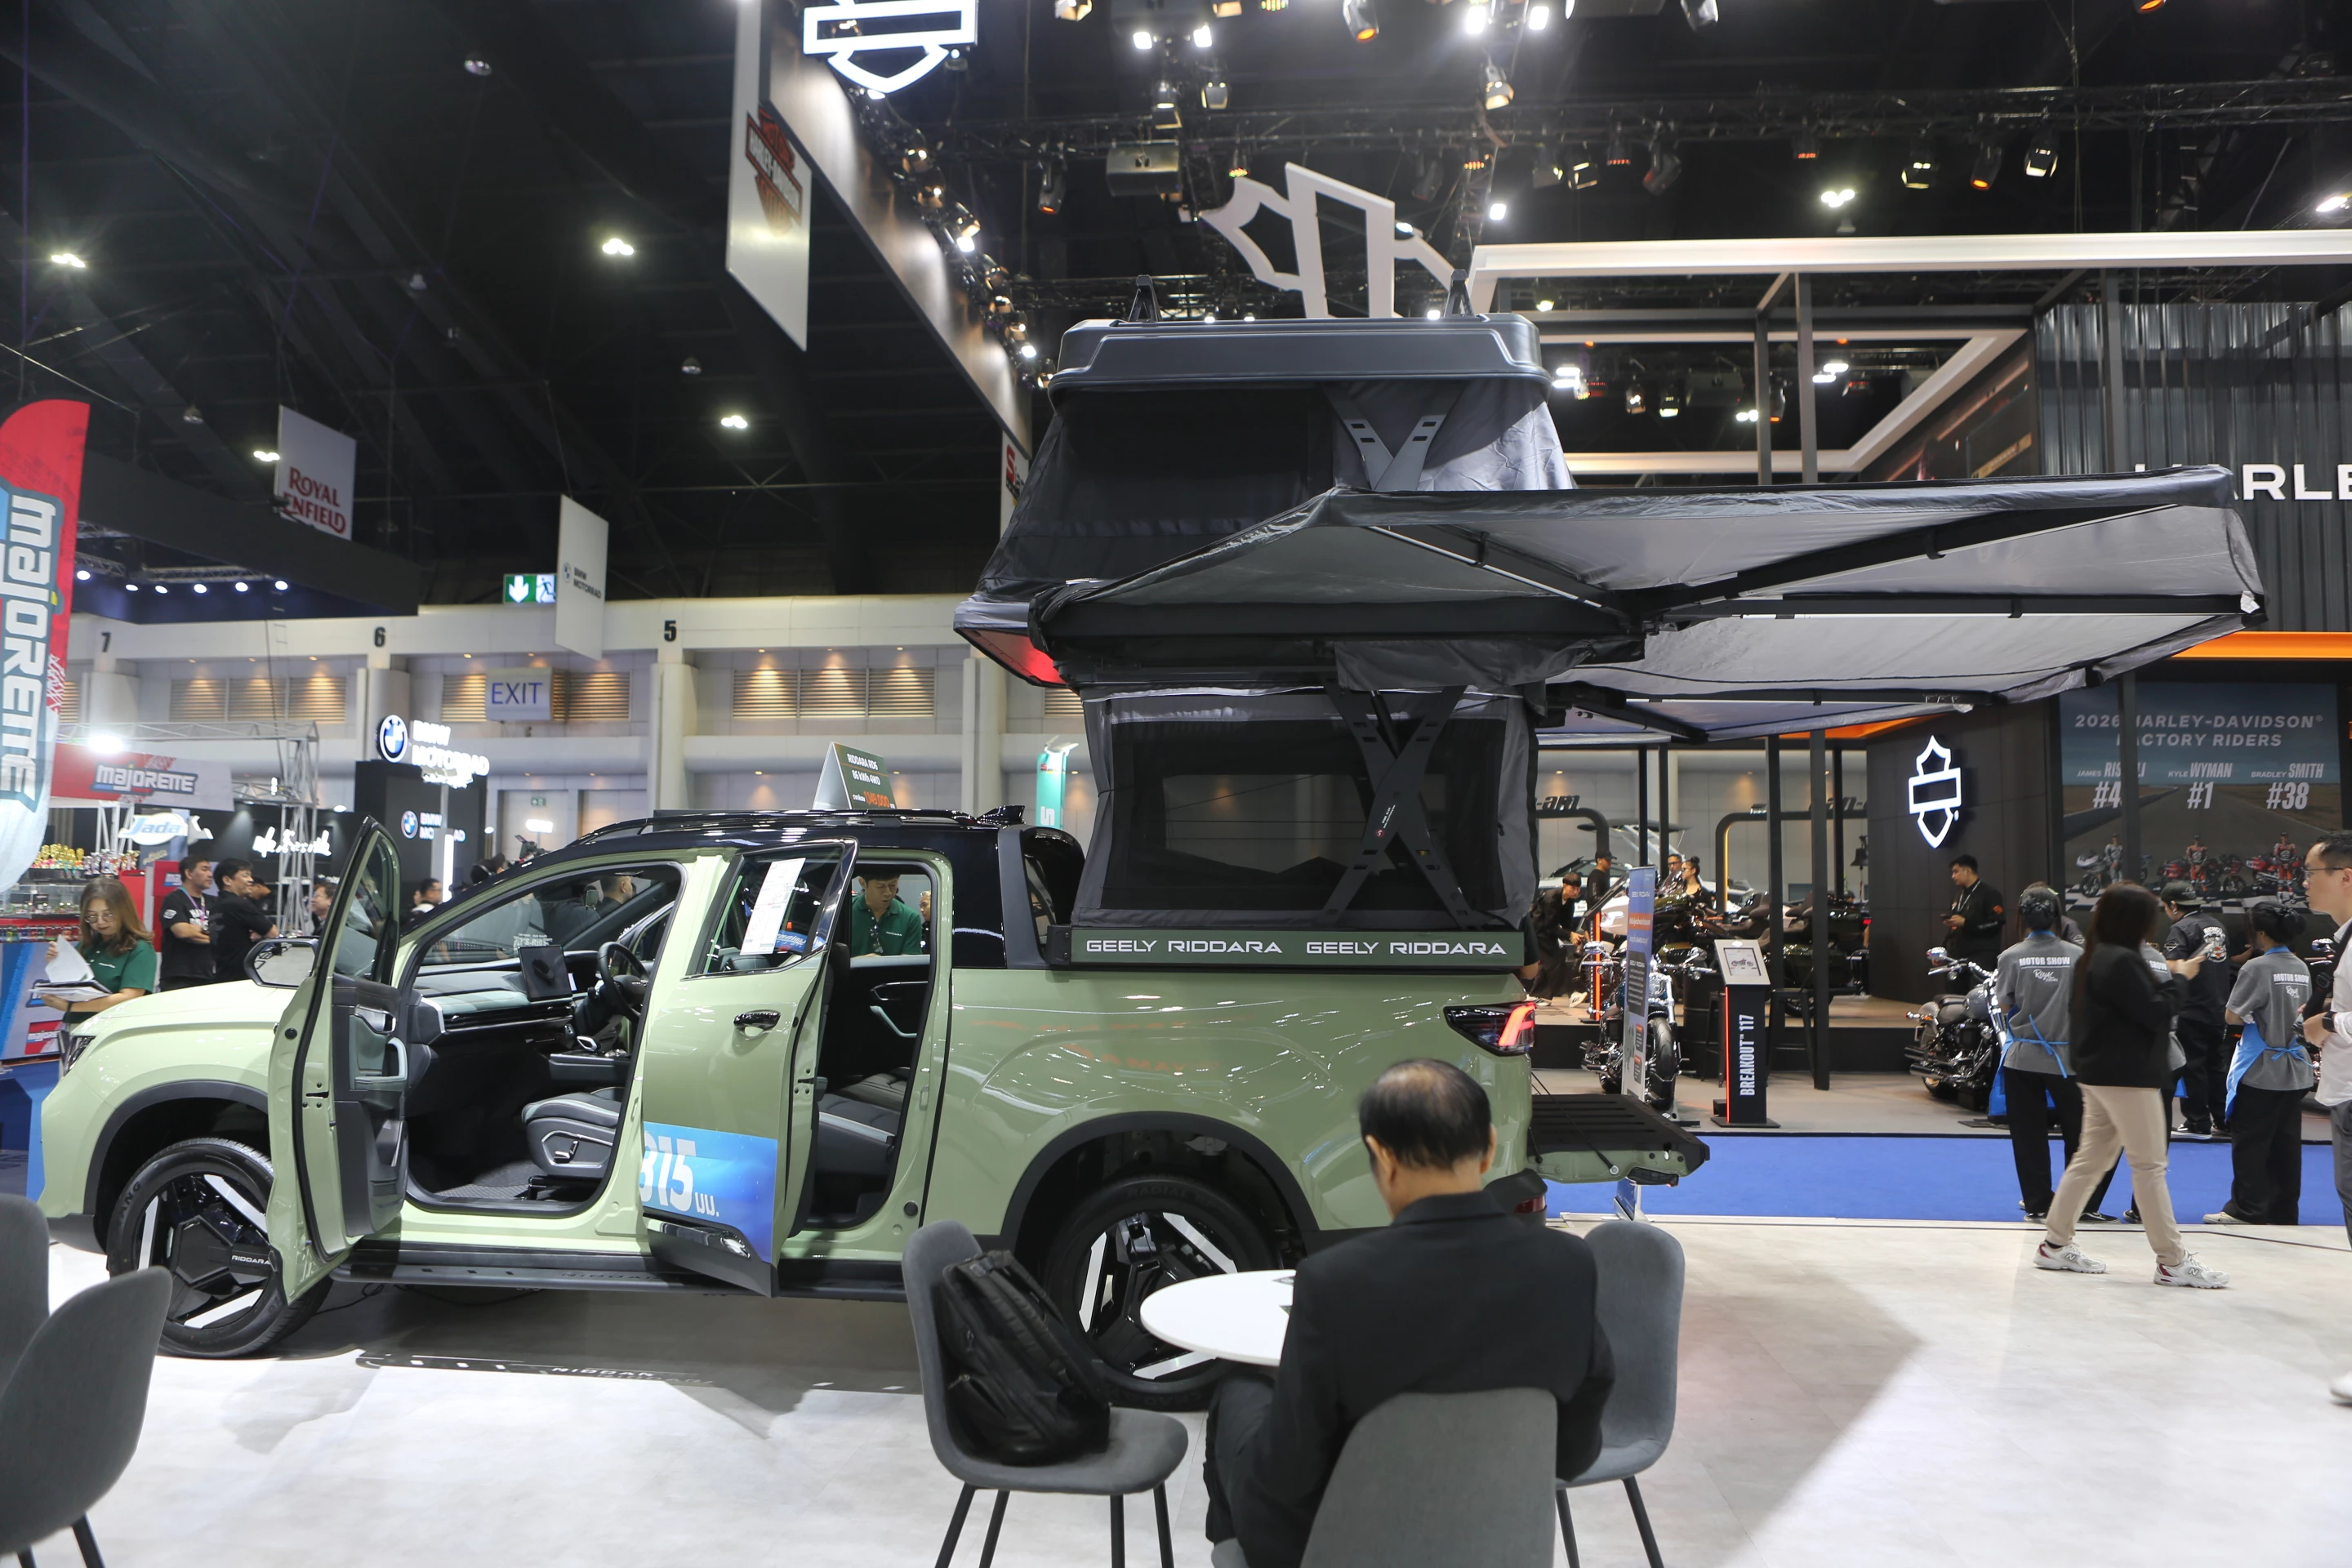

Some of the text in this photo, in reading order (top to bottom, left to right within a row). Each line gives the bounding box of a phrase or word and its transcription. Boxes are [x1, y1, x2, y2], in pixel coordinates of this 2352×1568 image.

[288, 466, 341, 507] ROYAL
[373, 626, 386, 648] 6
[663, 620, 677, 642] 5
[100, 631, 112, 653] 7
[491, 681, 544, 705] EXIT
[2074, 714, 2120, 728] 2026
[412, 719, 452, 746] BMW
[2116, 733, 2282, 747] CTORY RIDERS
[2077, 769, 2102, 777] JAMES
[2168, 761, 2234, 778] KYLE WYMAN
[2288, 762, 2324, 779] SMITH
[2186, 781, 2214, 809] #1
[2265, 781, 2310, 810] #38
[123, 817, 181, 835] Jada
[419, 812, 443, 826] BMW
[1086, 939, 1508, 955] GEELY RIDDARA GEELY RIDDARA
[2019, 956, 2070, 967] MOTOR SHOW
[2273, 973, 2294, 982] MOTOR
[1739, 1014, 1754, 1031] 117
[231, 1254, 271, 1266] RIDDARA
